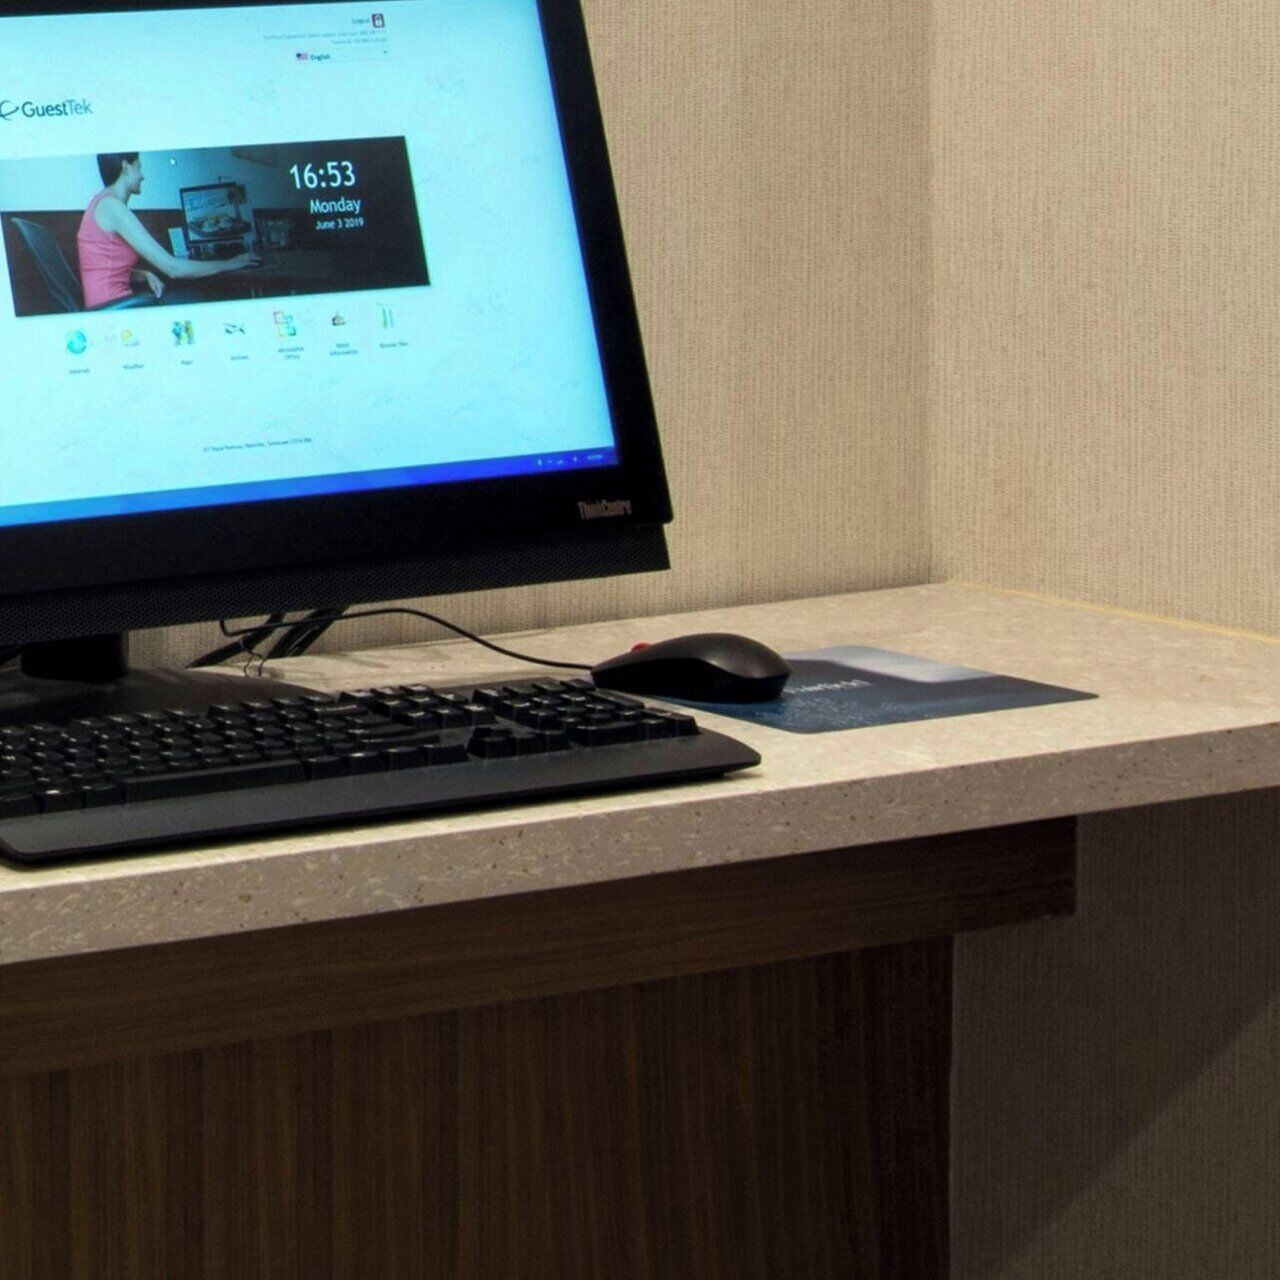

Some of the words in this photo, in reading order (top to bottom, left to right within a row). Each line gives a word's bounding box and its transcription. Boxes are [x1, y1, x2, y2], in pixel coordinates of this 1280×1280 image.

[21, 99, 94, 118] GuestTek
[289, 160, 356, 189] 16:53
[309, 196, 361, 215] Monday
[316, 220, 336, 230] June
[337, 218, 343, 229] 3
[344, 217, 365, 229] 2019
